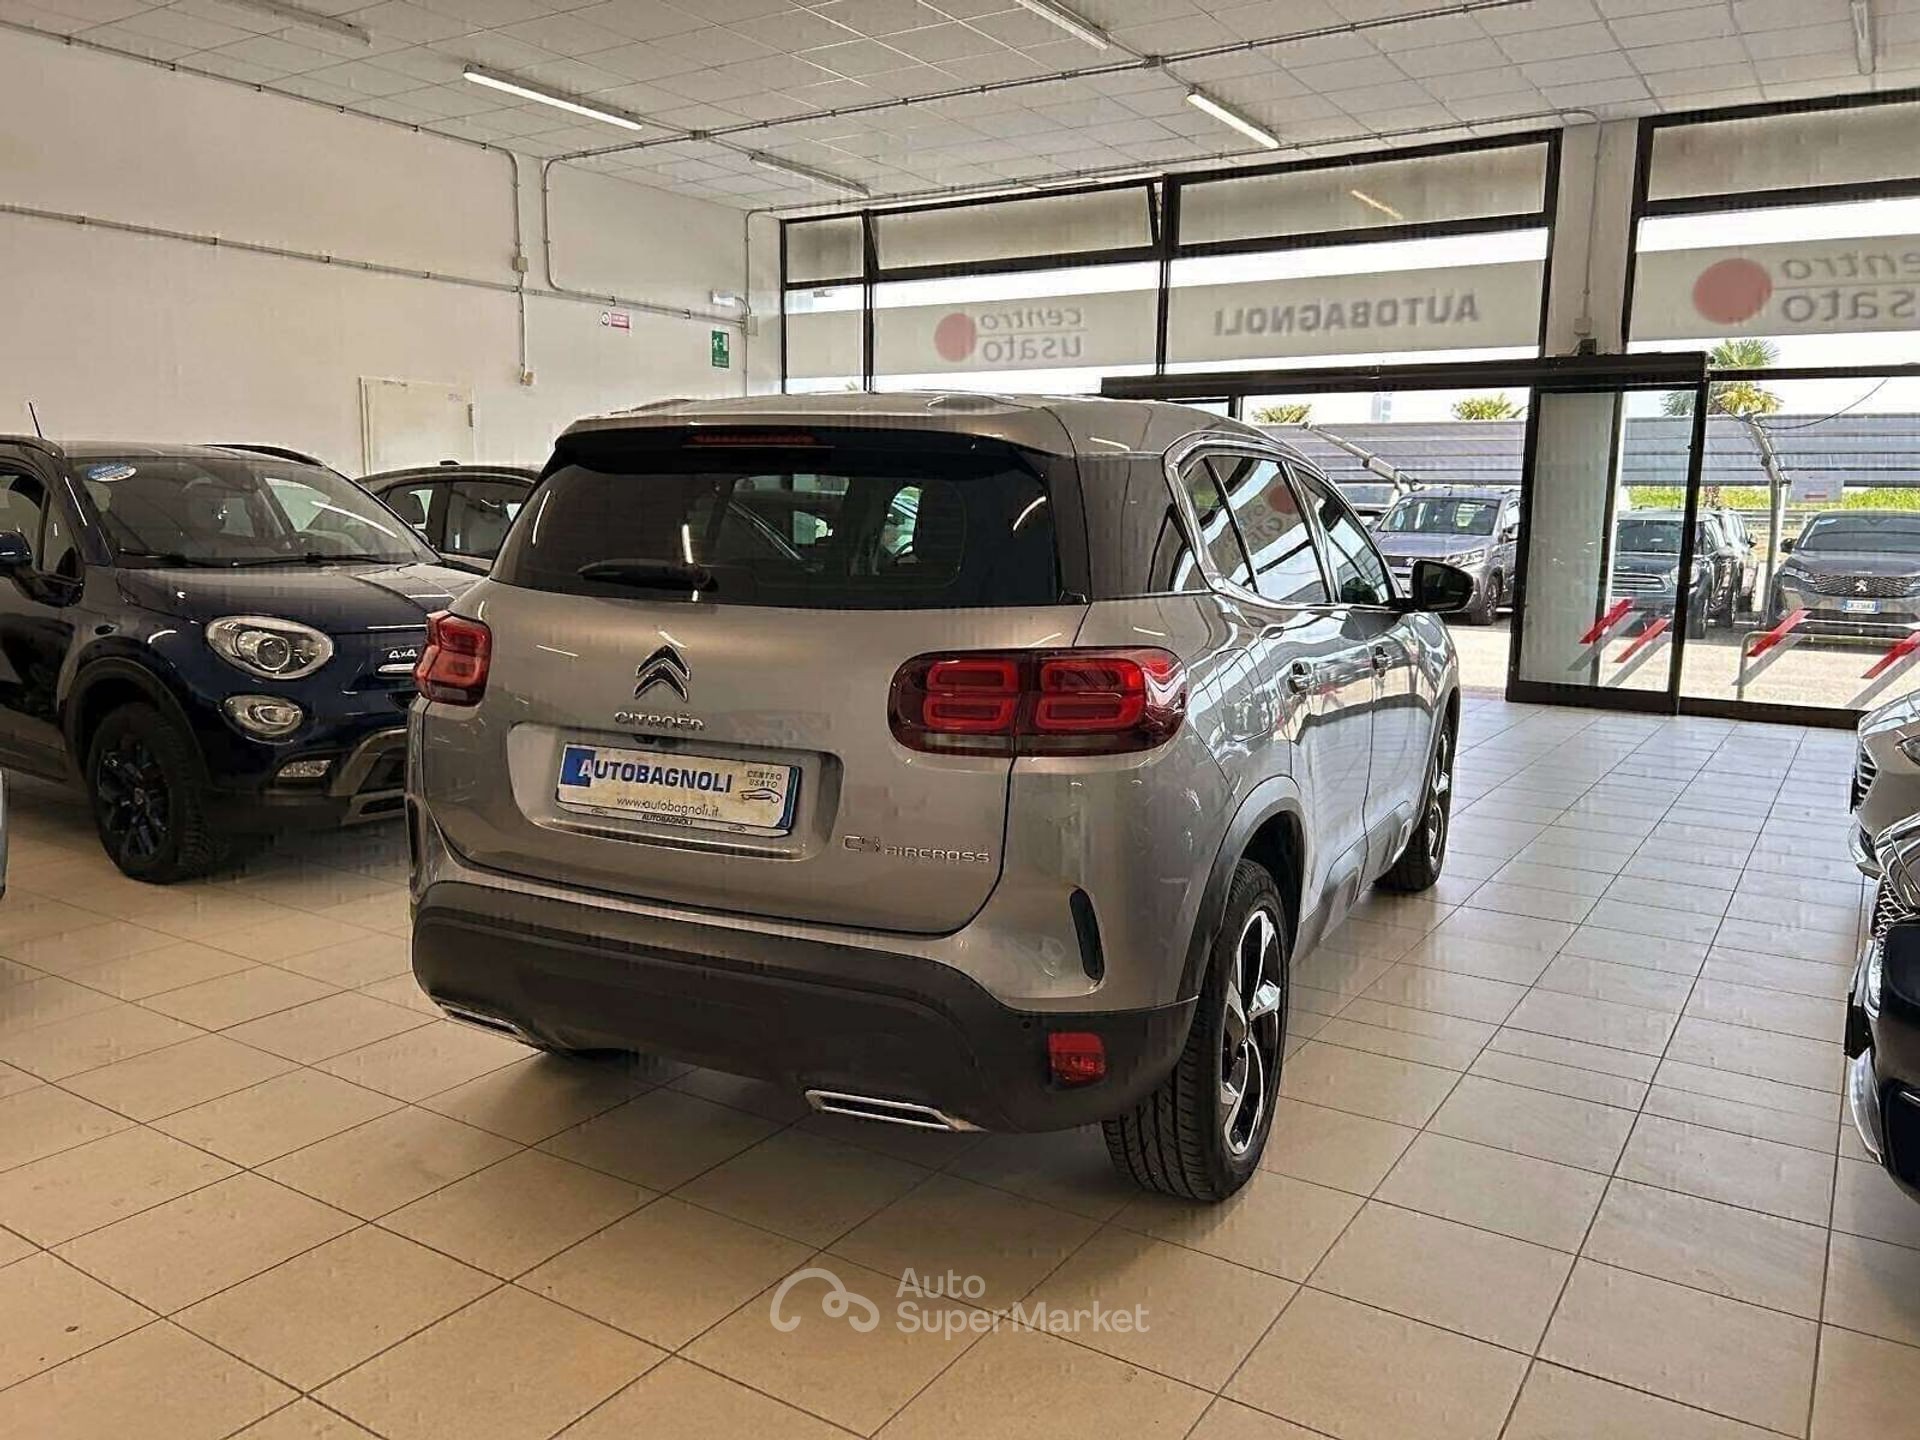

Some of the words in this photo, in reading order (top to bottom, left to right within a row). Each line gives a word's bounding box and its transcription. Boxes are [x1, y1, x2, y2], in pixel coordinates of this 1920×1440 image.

[578, 758, 733, 794] AUTOBAGNOLI
[747, 769, 783, 781] CENTRO
[748, 780, 778, 789] USATO
